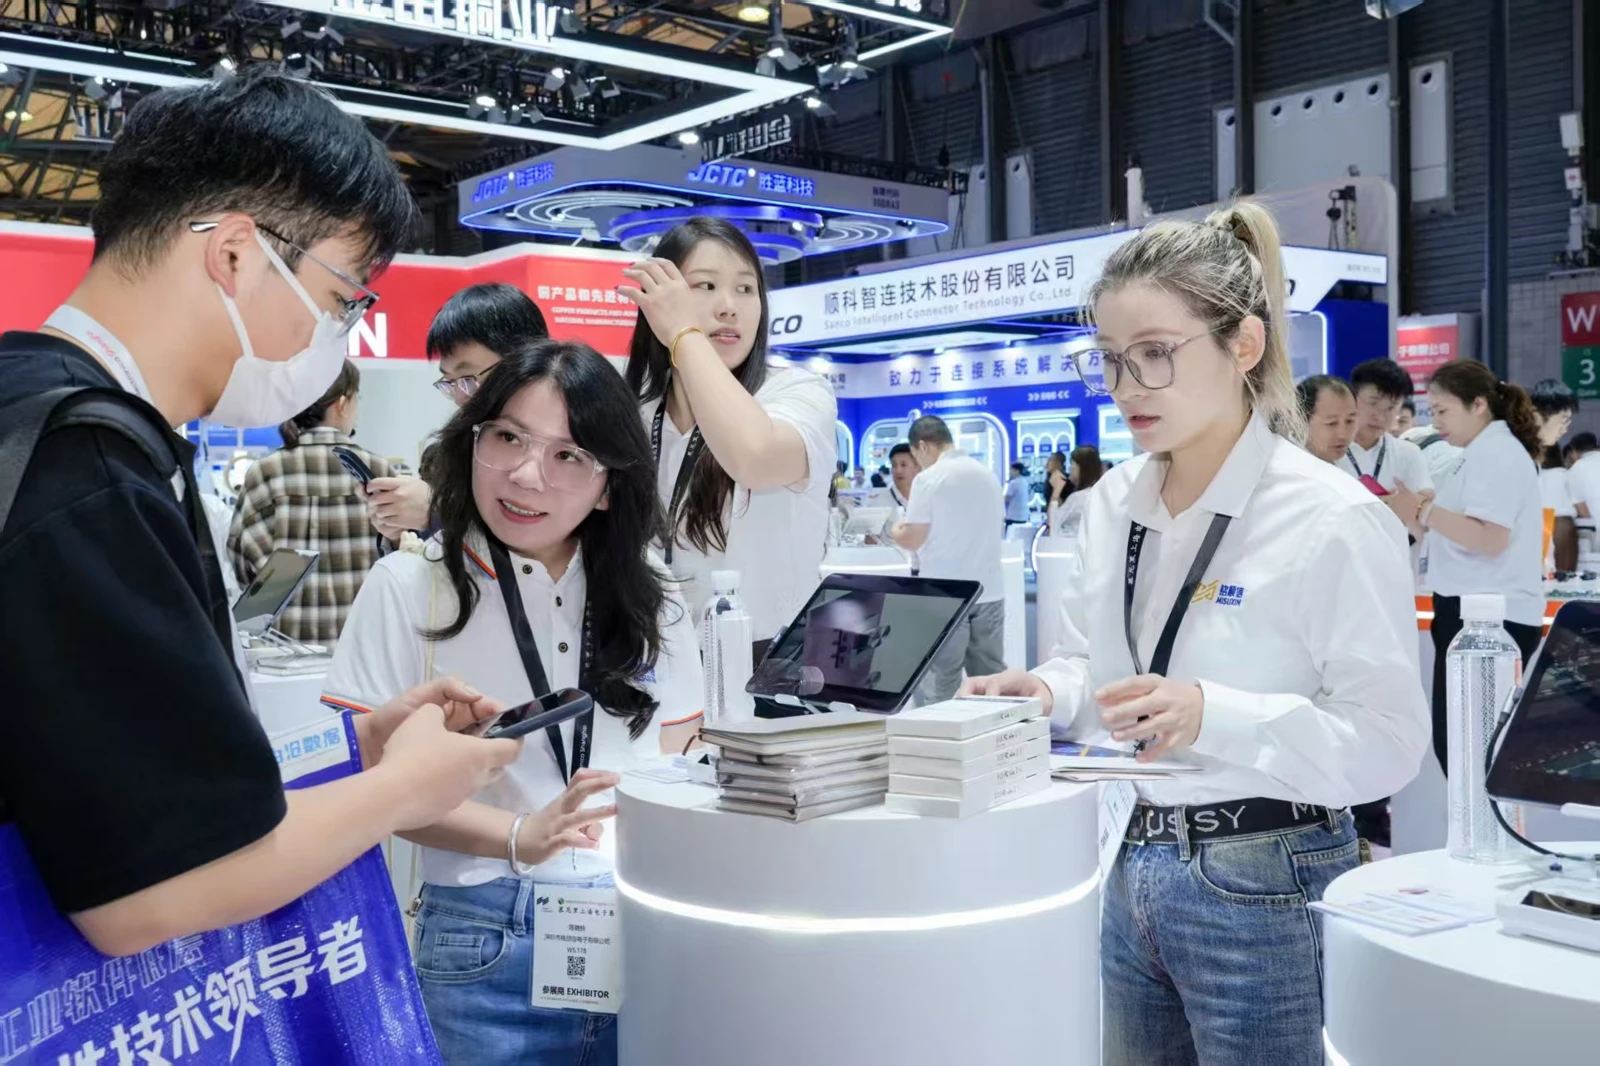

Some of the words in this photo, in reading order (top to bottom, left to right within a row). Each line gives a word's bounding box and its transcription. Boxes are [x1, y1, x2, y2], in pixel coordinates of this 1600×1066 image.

[473, 172, 508, 203] JCTC
[688, 164, 747, 187] JCTC
[760, 172, 814, 196] 胜蓝科技
[824, 255, 1075, 315] 顺科智连技术股份有限公司
[853, 309, 904, 327] Intelligent
[906, 304, 959, 319] Connector
[963, 292, 1025, 312] Technology
[1579, 359, 1596, 385] 3
[580, 724, 588, 753] Shanghai
[1145, 805, 1247, 837] USSY
[542, 985, 565, 996] 参展商
[566, 987, 610, 999] EXHIBITOR
